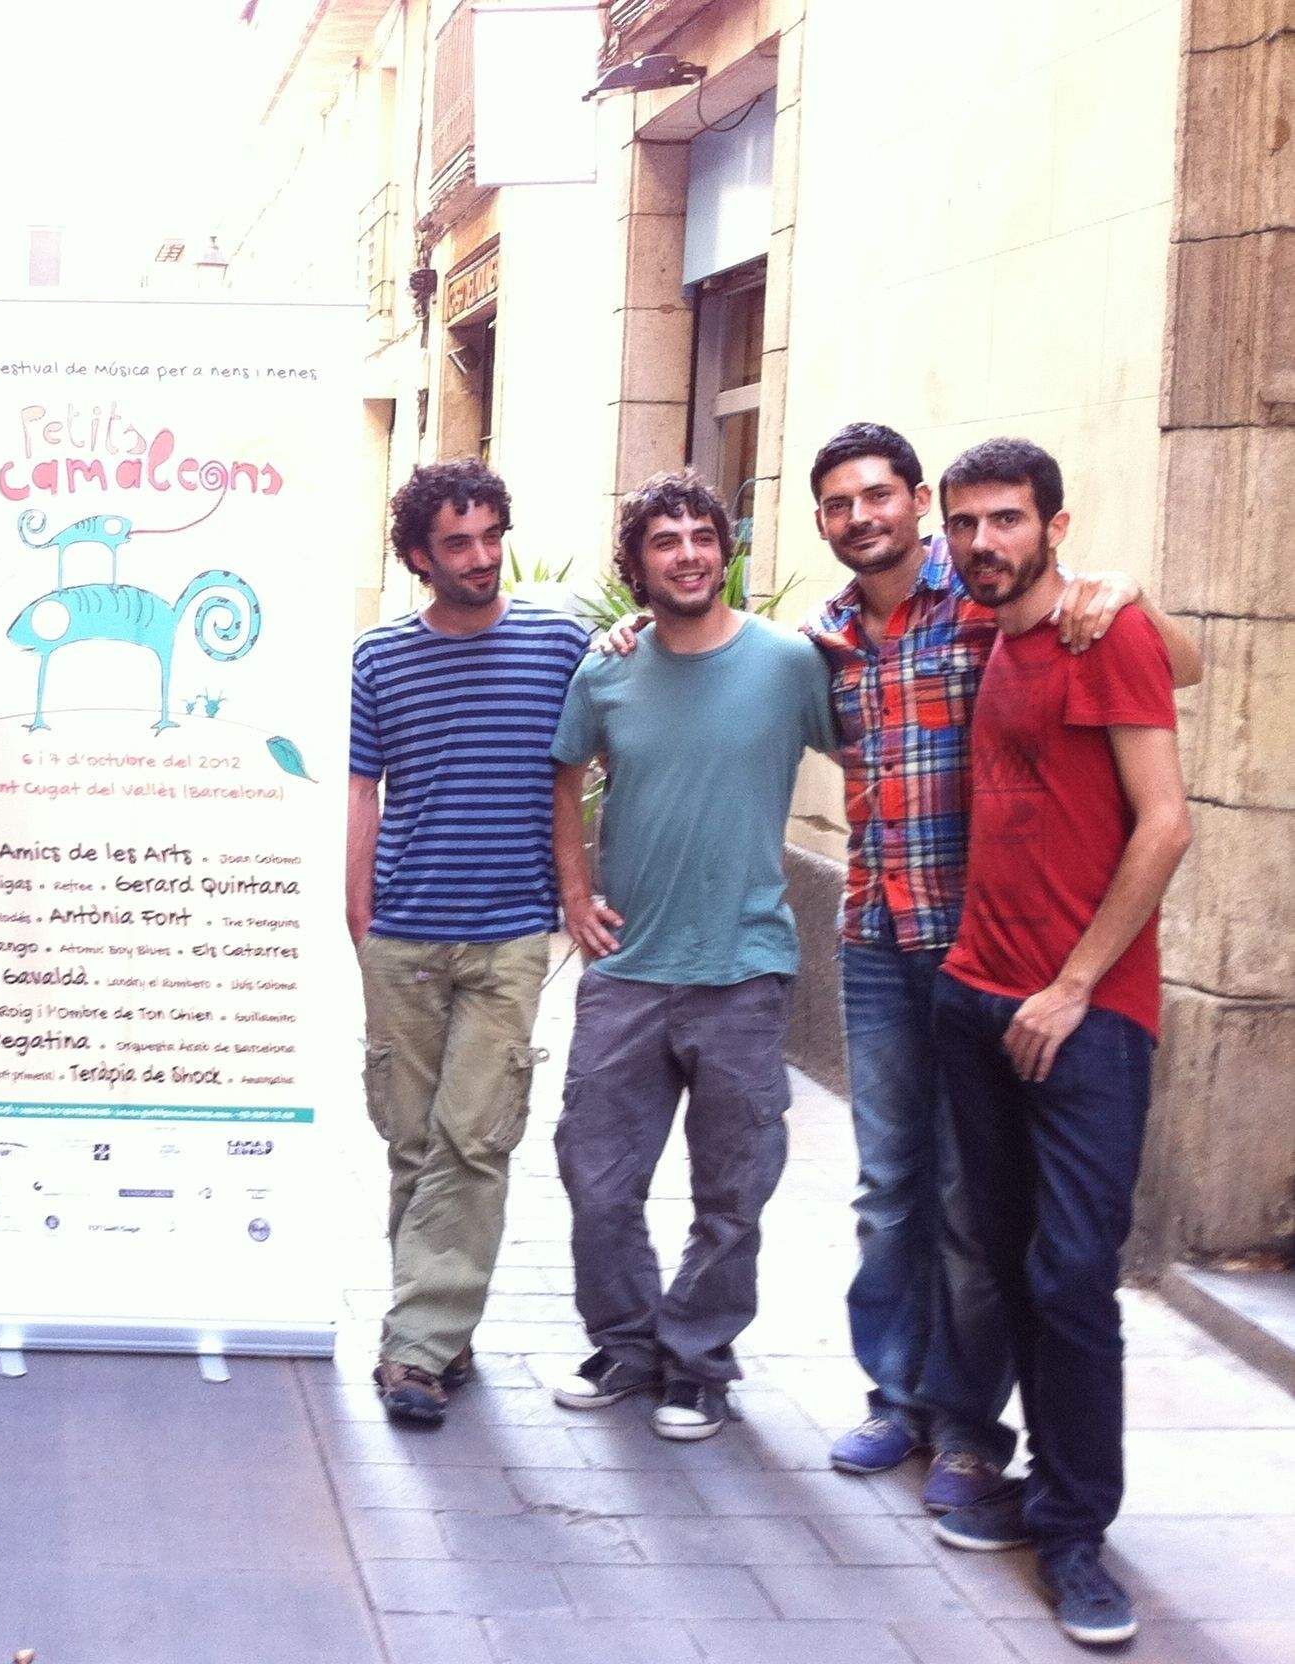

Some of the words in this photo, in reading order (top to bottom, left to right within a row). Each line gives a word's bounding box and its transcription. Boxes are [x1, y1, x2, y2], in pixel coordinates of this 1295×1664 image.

[65, 362, 87, 375] de
[157, 365, 187, 382] per
[192, 366, 203, 377] a
[210, 366, 250, 379] nens
[267, 367, 318, 381] nenes
[21, 400, 147, 459] Petits
[22, 753, 33, 765] 6
[39, 751, 43, 765] i
[49, 752, 61, 765] 7
[66, 752, 157, 768] d'octubre
[162, 754, 192, 769] del
[198, 755, 242, 770] 2012
[24, 781, 81, 802] Cugat
[86, 782, 115, 796] del
[183, 783, 284, 801] (Barcelona)
[0, 840, 61, 863] Amics
[68, 842, 98, 861] de
[105, 842, 137, 864] les
[144, 843, 192, 865] Arts
[115, 875, 194, 894] Gerard
[201, 874, 301, 898] Quintana
[49, 903, 135, 926] Antònia
[141, 906, 193, 927] Font
[192, 941, 217, 958] Els
[222, 942, 299, 960] Catarres
[3, 964, 90, 987] Gavaldà
[114, 1005, 134, 1021] de
[138, 1006, 165, 1021] Ton
[169, 1008, 214, 1022] Chien
[69, 1060, 138, 1091] Teràpia
[141, 1065, 166, 1084] de
[171, 1064, 223, 1086] Shock
